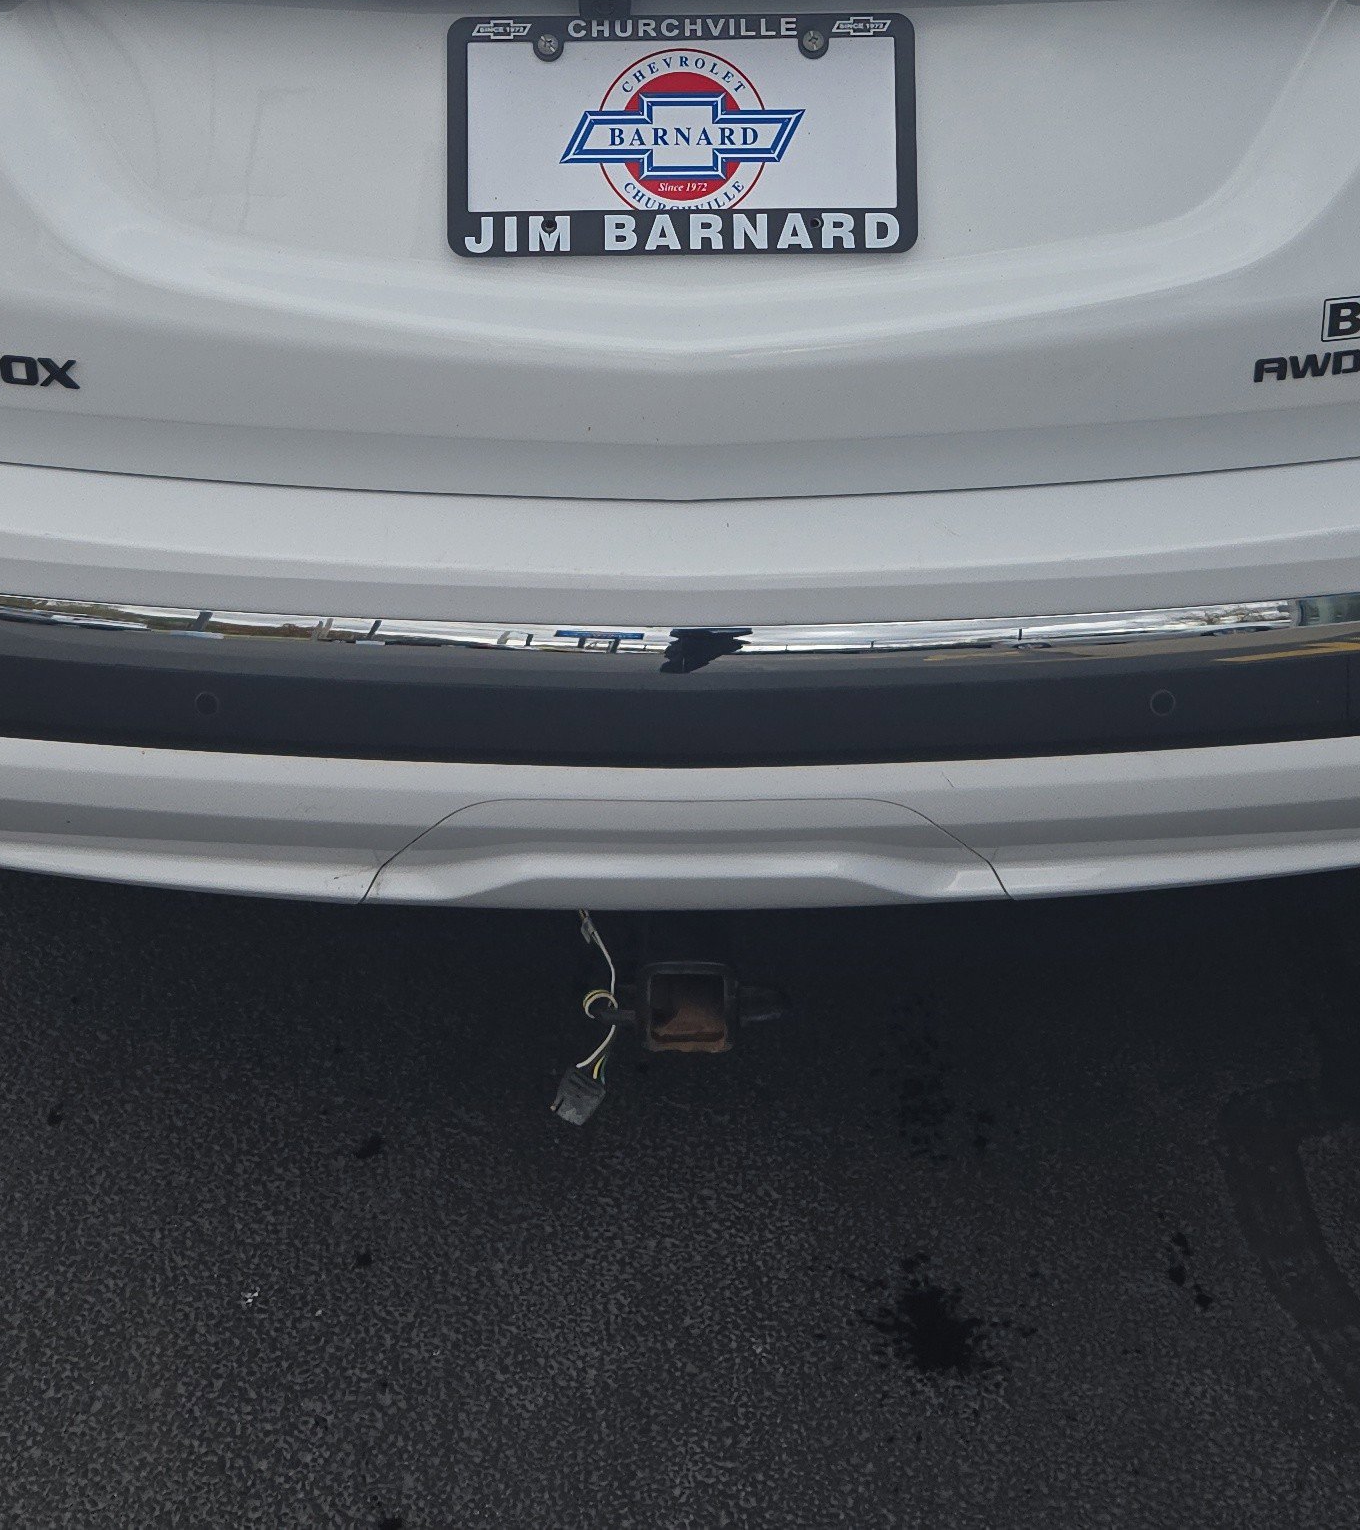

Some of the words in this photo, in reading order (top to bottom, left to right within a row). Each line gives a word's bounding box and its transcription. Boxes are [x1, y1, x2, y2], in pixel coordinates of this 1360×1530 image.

[567, 17, 798, 38] CHURCHVILLE
[622, 56, 746, 94] CHEVROLET
[609, 127, 759, 146] BARNARD
[658, 182, 684, 192] Since
[685, 182, 708, 192] 1972
[464, 215, 571, 254] JIM
[604, 212, 901, 251] BARNARD
